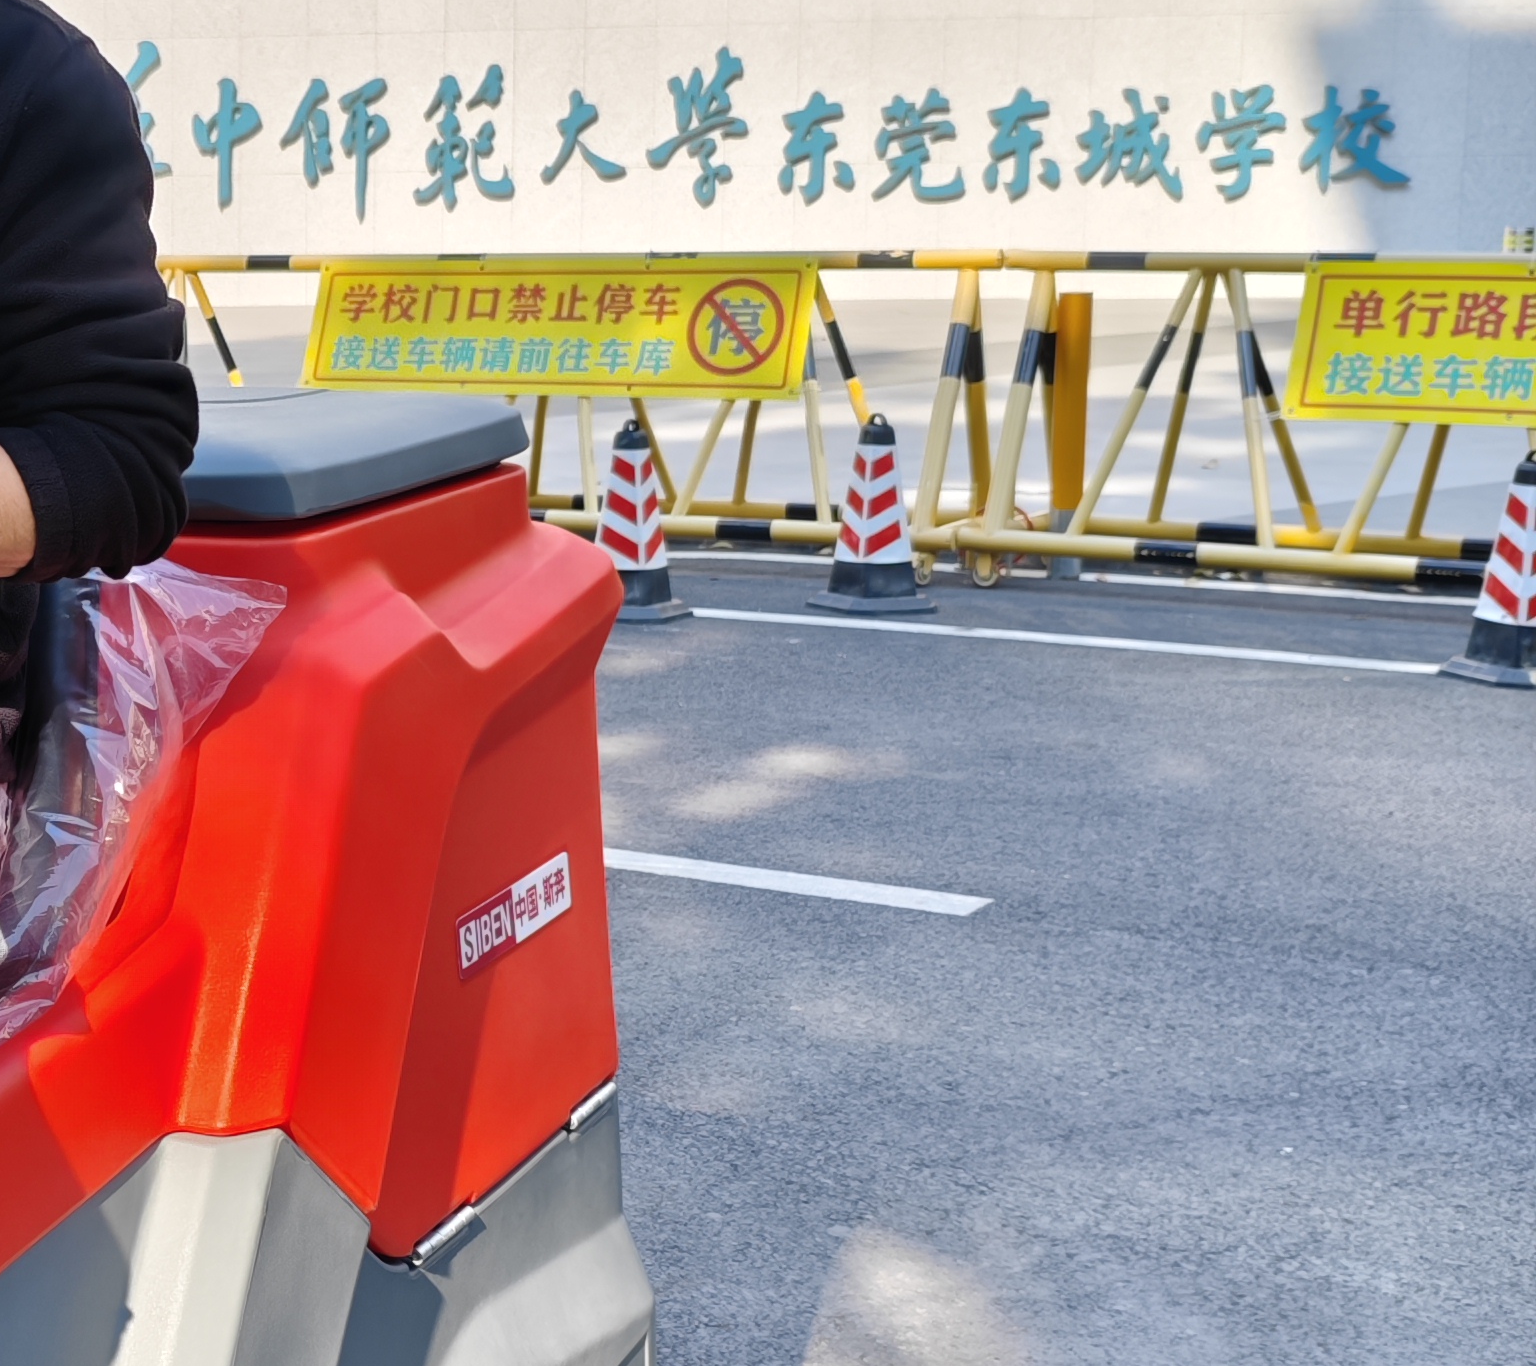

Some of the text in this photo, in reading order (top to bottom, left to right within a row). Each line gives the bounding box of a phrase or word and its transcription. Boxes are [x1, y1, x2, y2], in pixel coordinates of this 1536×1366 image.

[339, 282, 682, 325] 学校门口禁止停车
[705, 298, 766, 357] 停
[330, 335, 676, 376] 接送车辆请前往车库
[1324, 351, 1536, 401] 接送车辆
[459, 899, 513, 969] SIBEN
